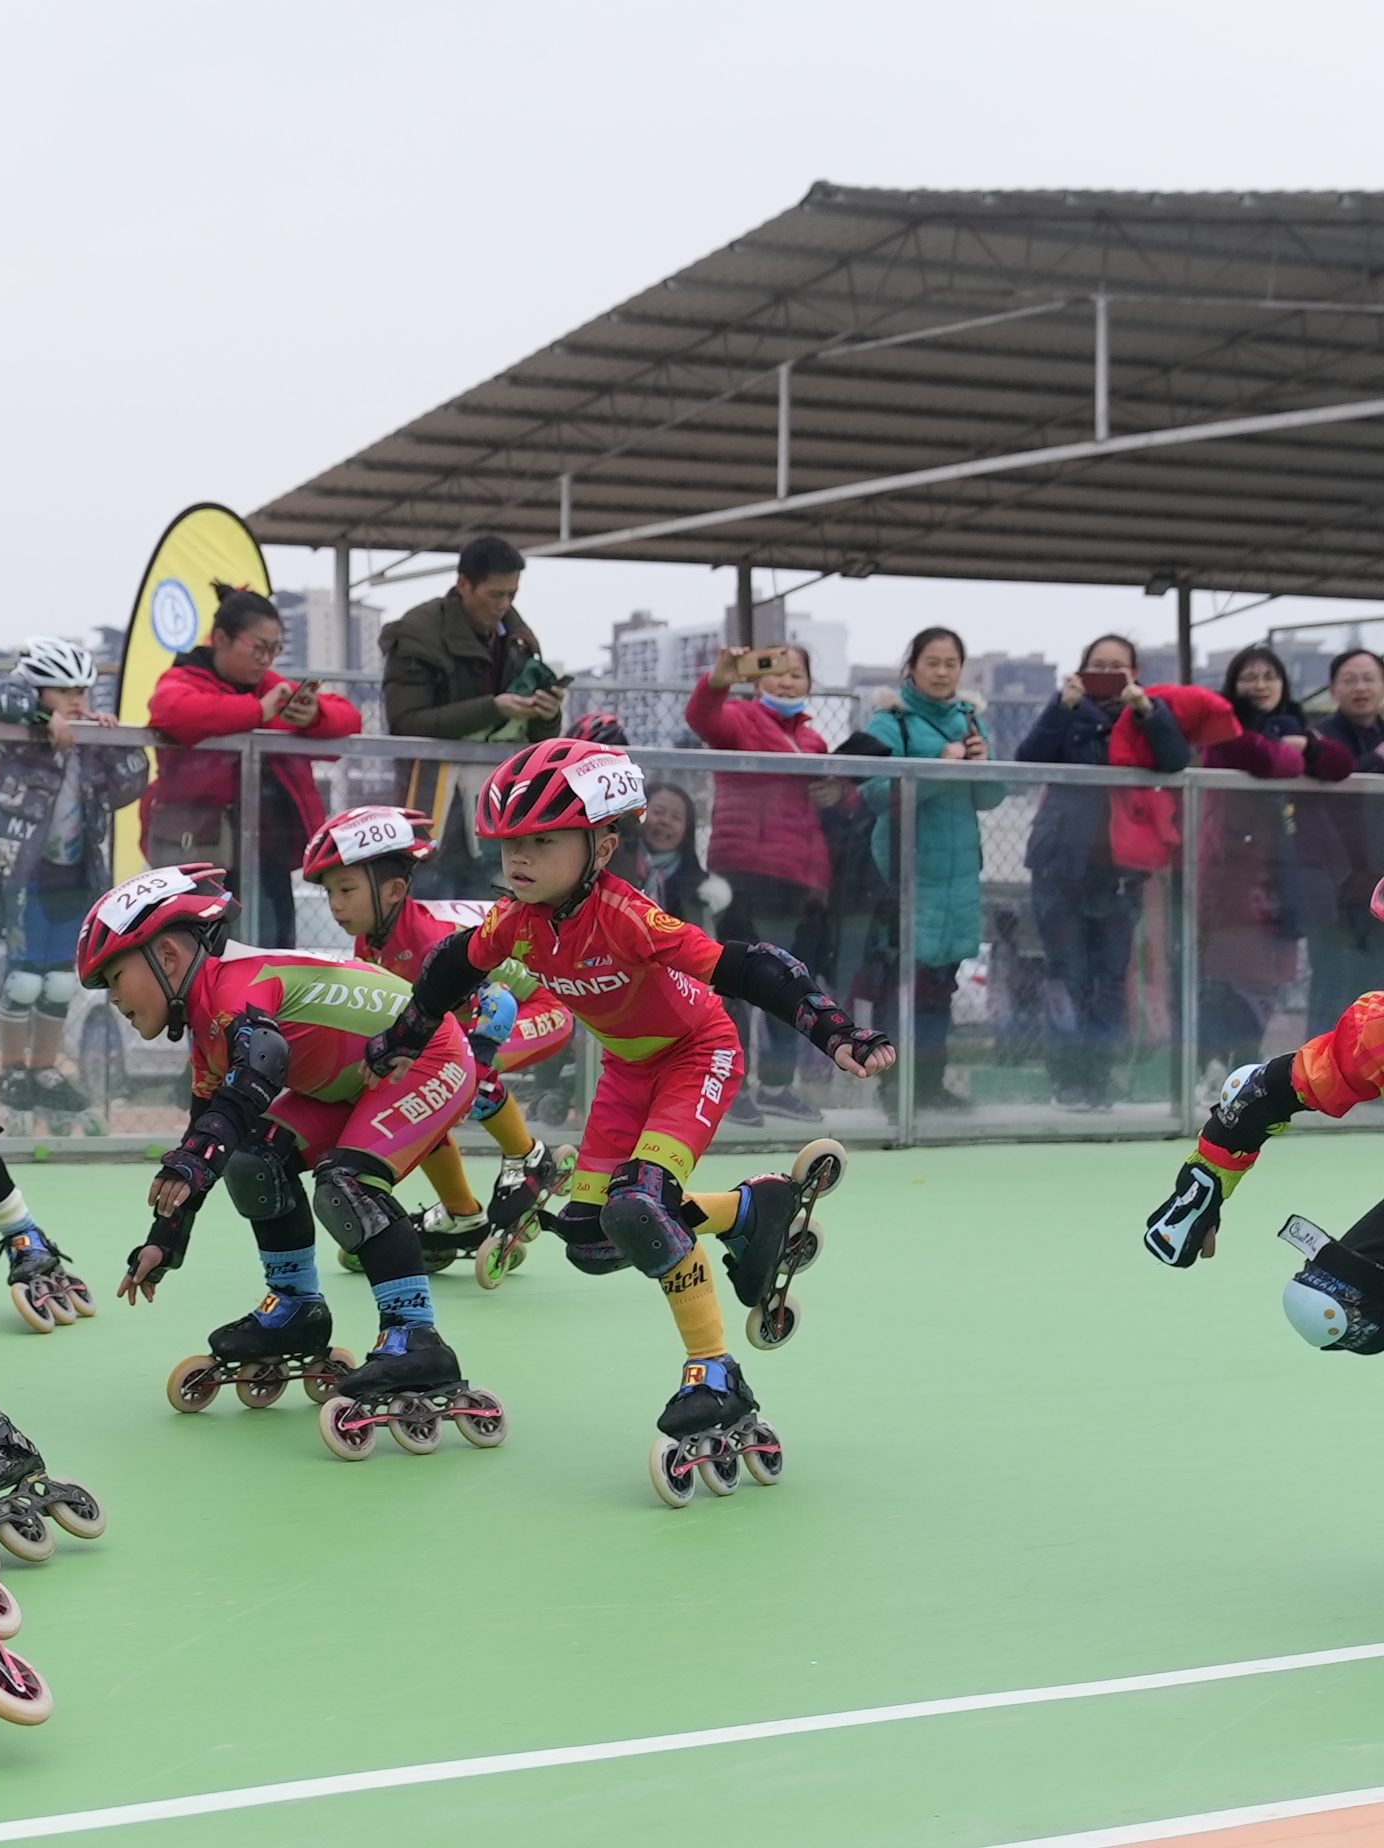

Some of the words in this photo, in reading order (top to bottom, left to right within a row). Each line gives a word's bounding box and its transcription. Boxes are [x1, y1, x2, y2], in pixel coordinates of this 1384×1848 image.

[597, 769, 639, 801] 236
[354, 822, 397, 849] 280
[301, 981, 412, 1018] ZDSST
[370, 1061, 467, 1140] 广西战地
